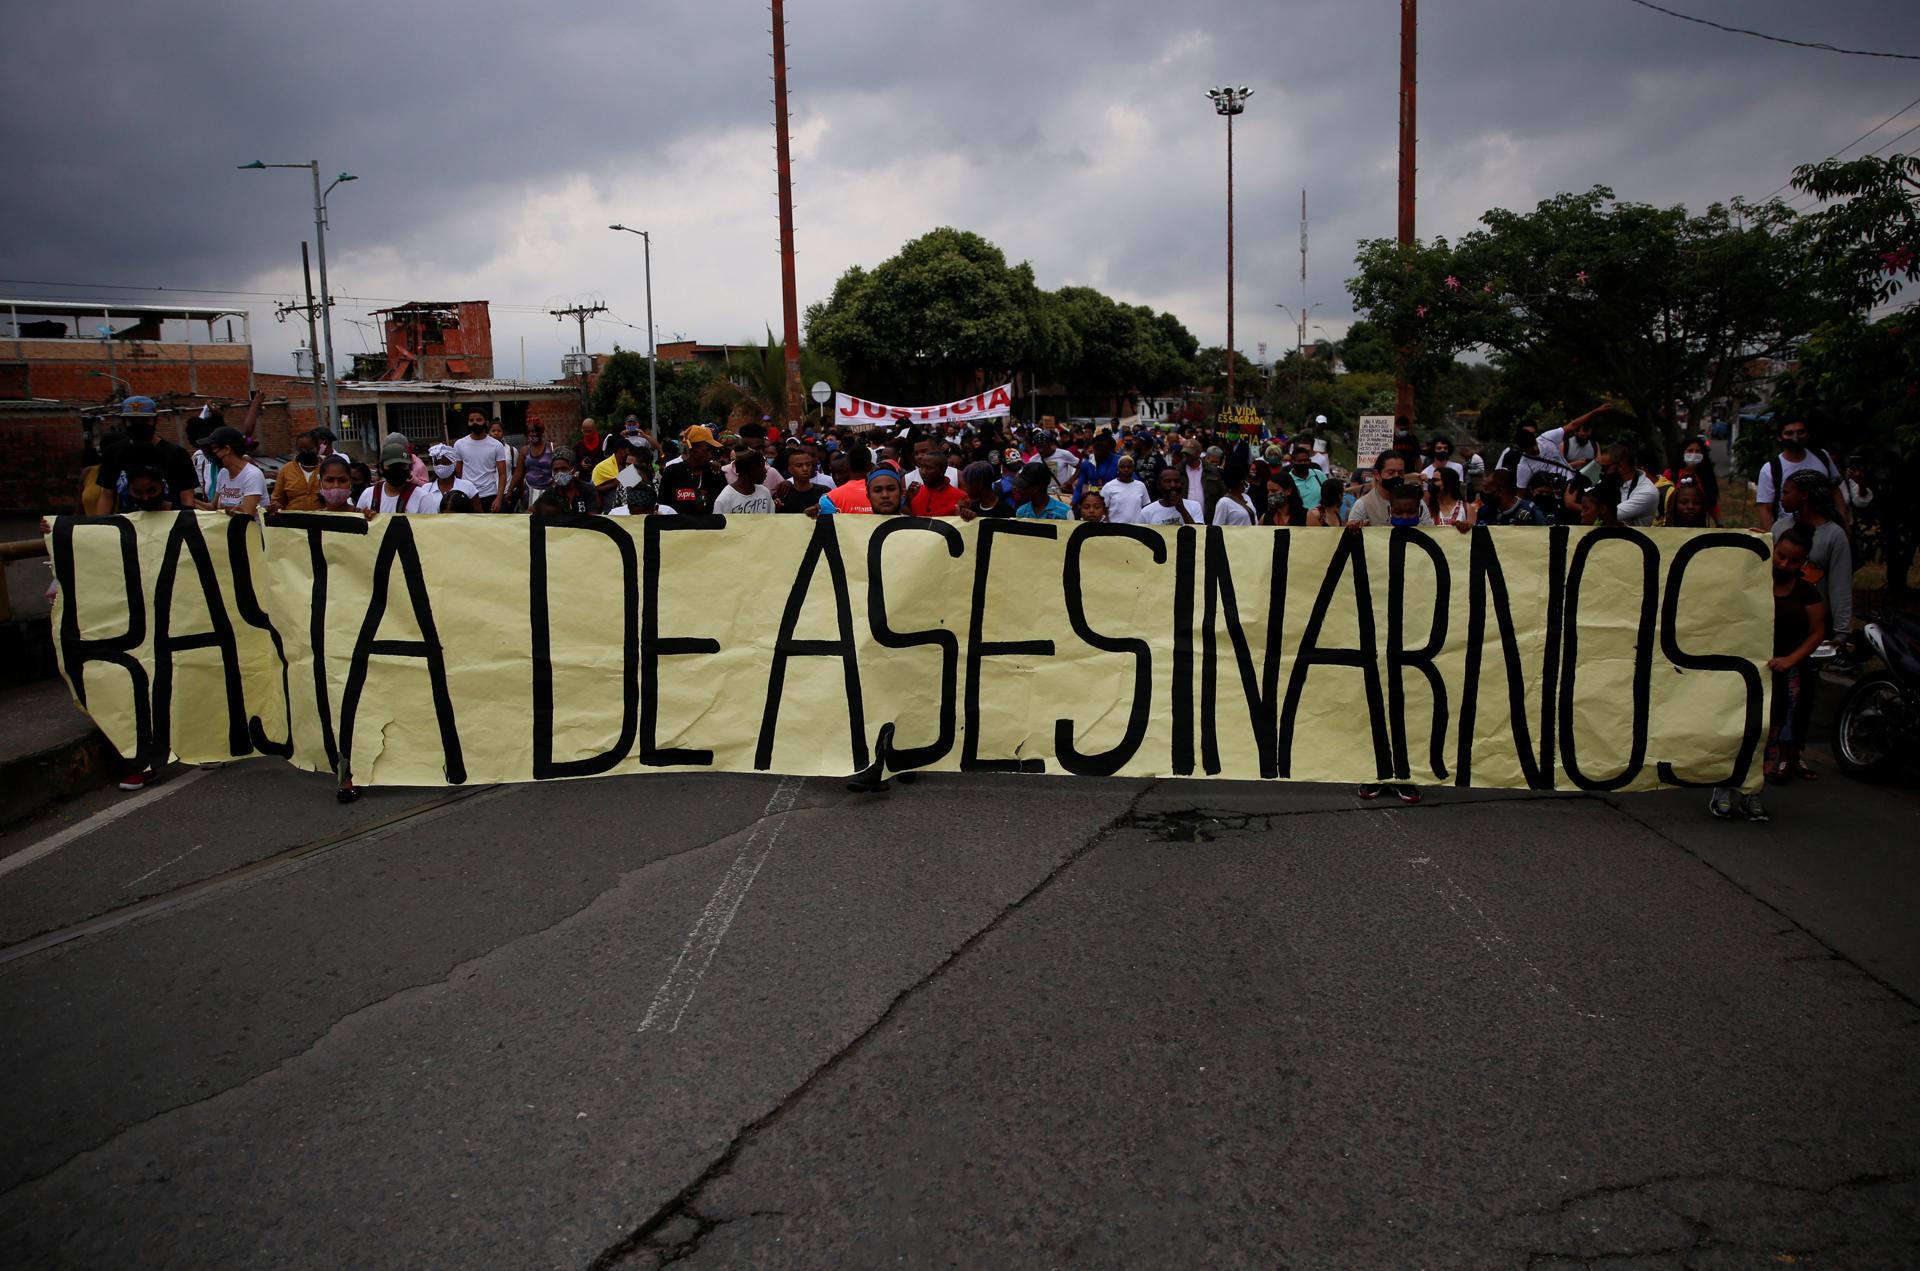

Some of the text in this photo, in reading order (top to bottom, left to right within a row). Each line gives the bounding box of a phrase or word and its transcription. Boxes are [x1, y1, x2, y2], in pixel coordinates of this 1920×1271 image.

[840, 388, 1010, 419] JUSTICIA
[1222, 405, 1257, 416] LA VIDA
[51, 510, 1771, 791] BASTA DE ASESINARNOS
